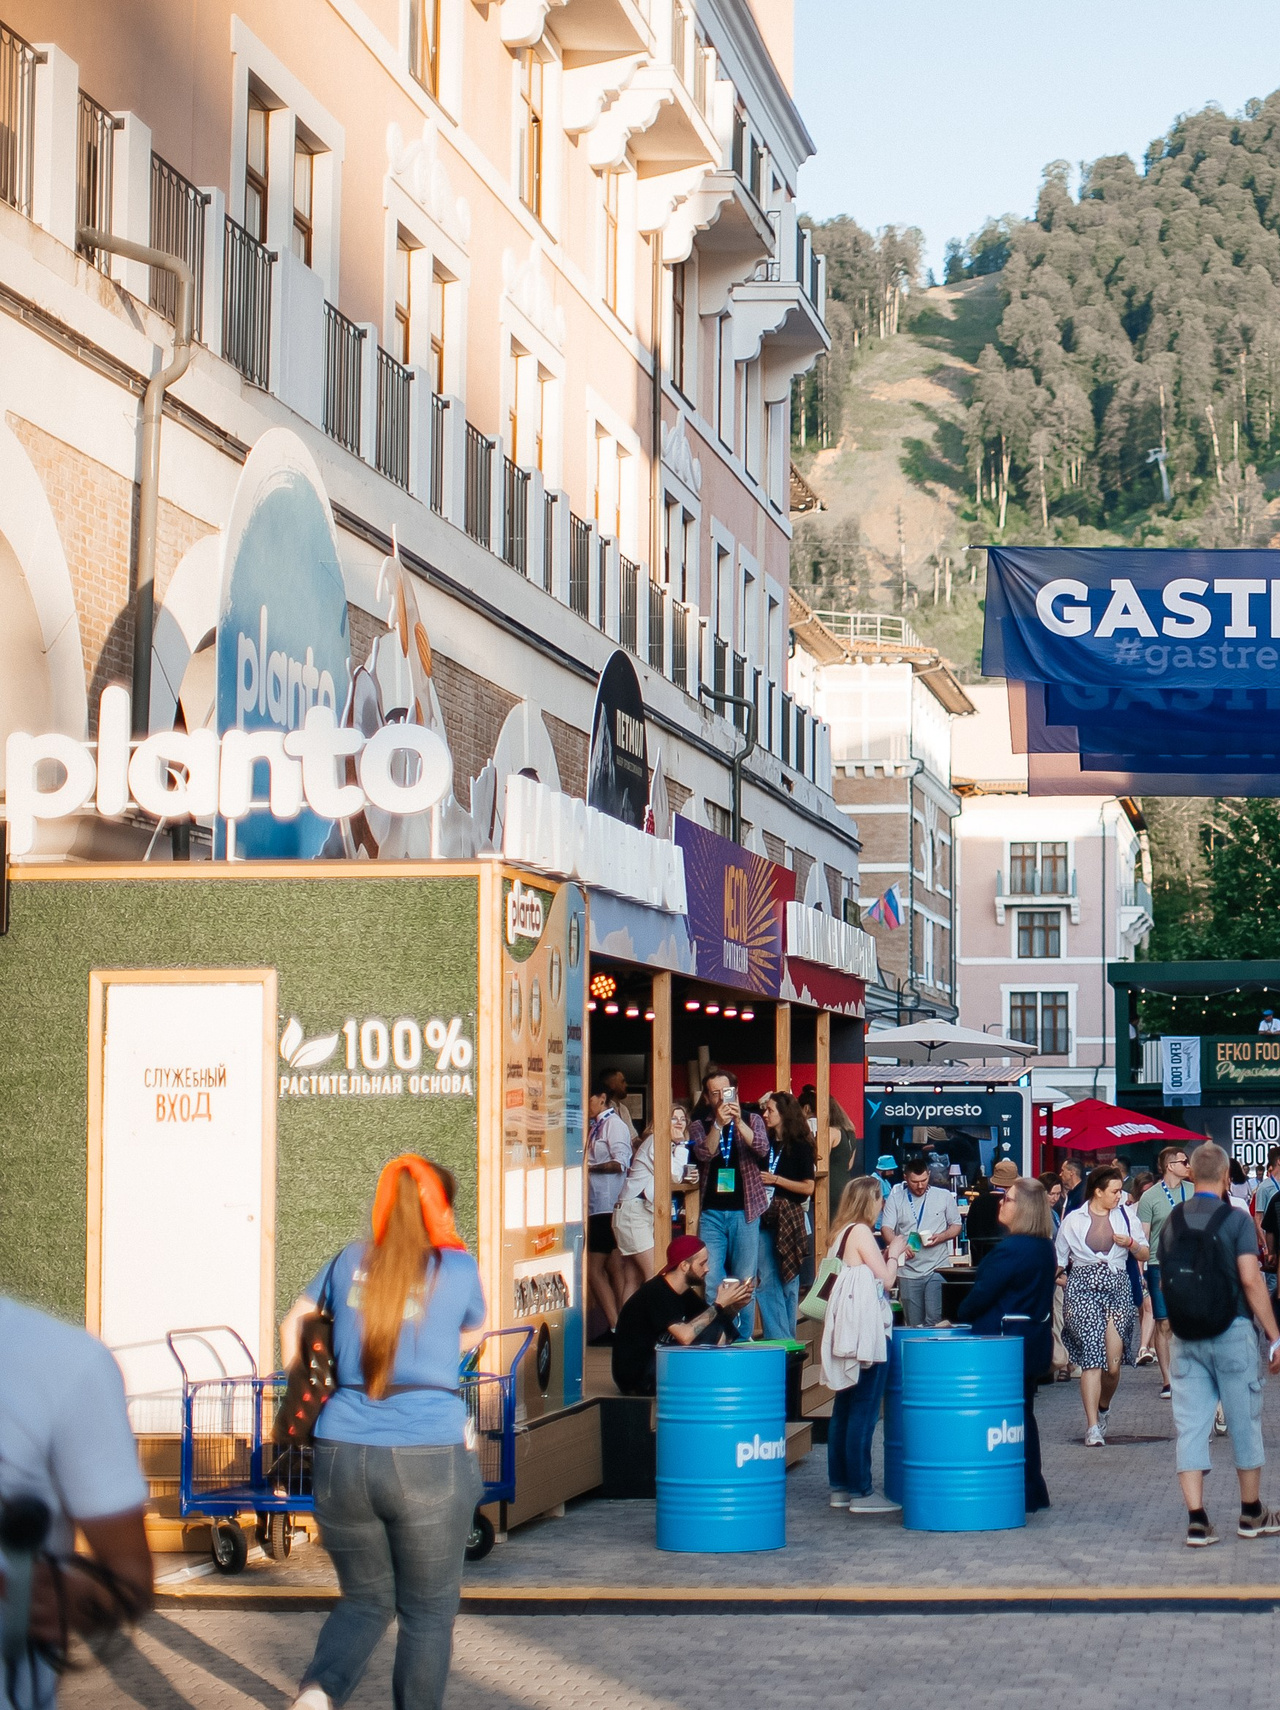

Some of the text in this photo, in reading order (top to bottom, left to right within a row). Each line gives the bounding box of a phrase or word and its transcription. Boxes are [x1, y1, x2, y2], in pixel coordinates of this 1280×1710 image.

[235, 604, 336, 732] planto
[5, 685, 454, 855] planto
[508, 883, 542, 942] planto
[341, 1017, 473, 1071] 100%
[1217, 1043, 1251, 1061] EFKO
[144, 1063, 227, 1088] СЛУЖЕБНЫЙ
[1170, 1042, 1183, 1088] EFKO FOOD
[279, 1074, 473, 1096] РАСТИТЕЛЬНАЯ ОСНОВА
[156, 1091, 212, 1122] ВХОД
[884, 1102, 983, 1120] sabypresto
[1232, 1115, 1279, 1141] EFKO
[736, 1433, 786, 1468] plant
[987, 1418, 1025, 1452] plan
